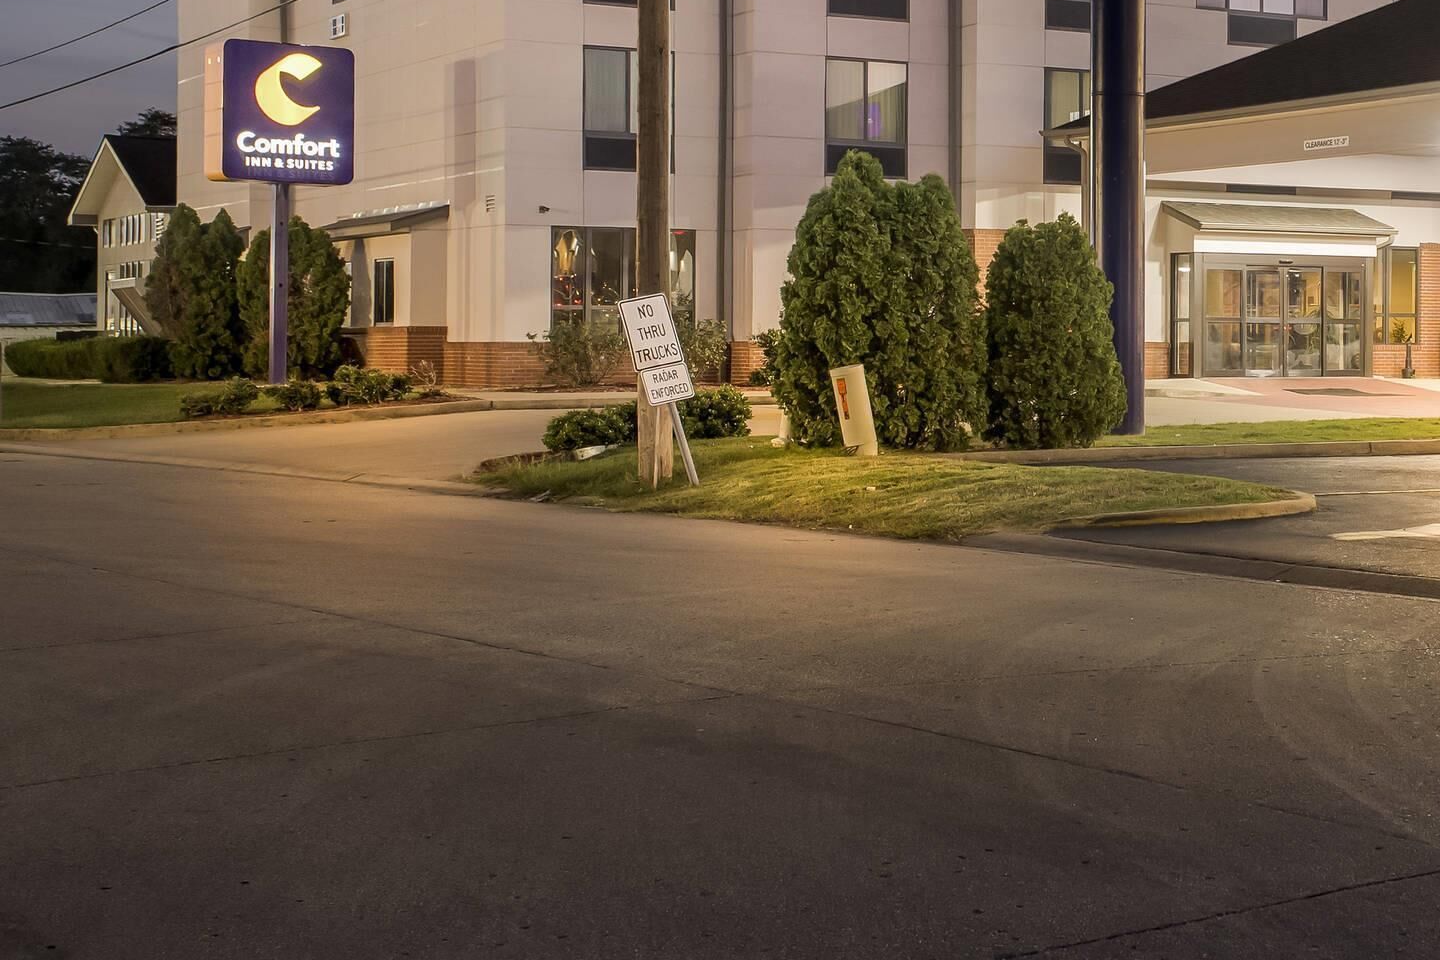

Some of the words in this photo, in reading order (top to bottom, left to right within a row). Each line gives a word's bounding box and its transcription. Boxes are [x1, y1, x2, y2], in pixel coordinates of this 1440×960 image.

[236, 131, 340, 158] Comfort
[1305, 139, 1333, 149] CLEARANCE
[245, 156, 271, 168] INN
[274, 158, 284, 168] &
[286, 158, 334, 171] SUITES
[637, 304, 654, 319] NO
[637, 323, 666, 341] THRU
[635, 342, 679, 363] TRUCKS
[652, 369, 679, 384] RADAR
[651, 383, 689, 400] ENFORCED
